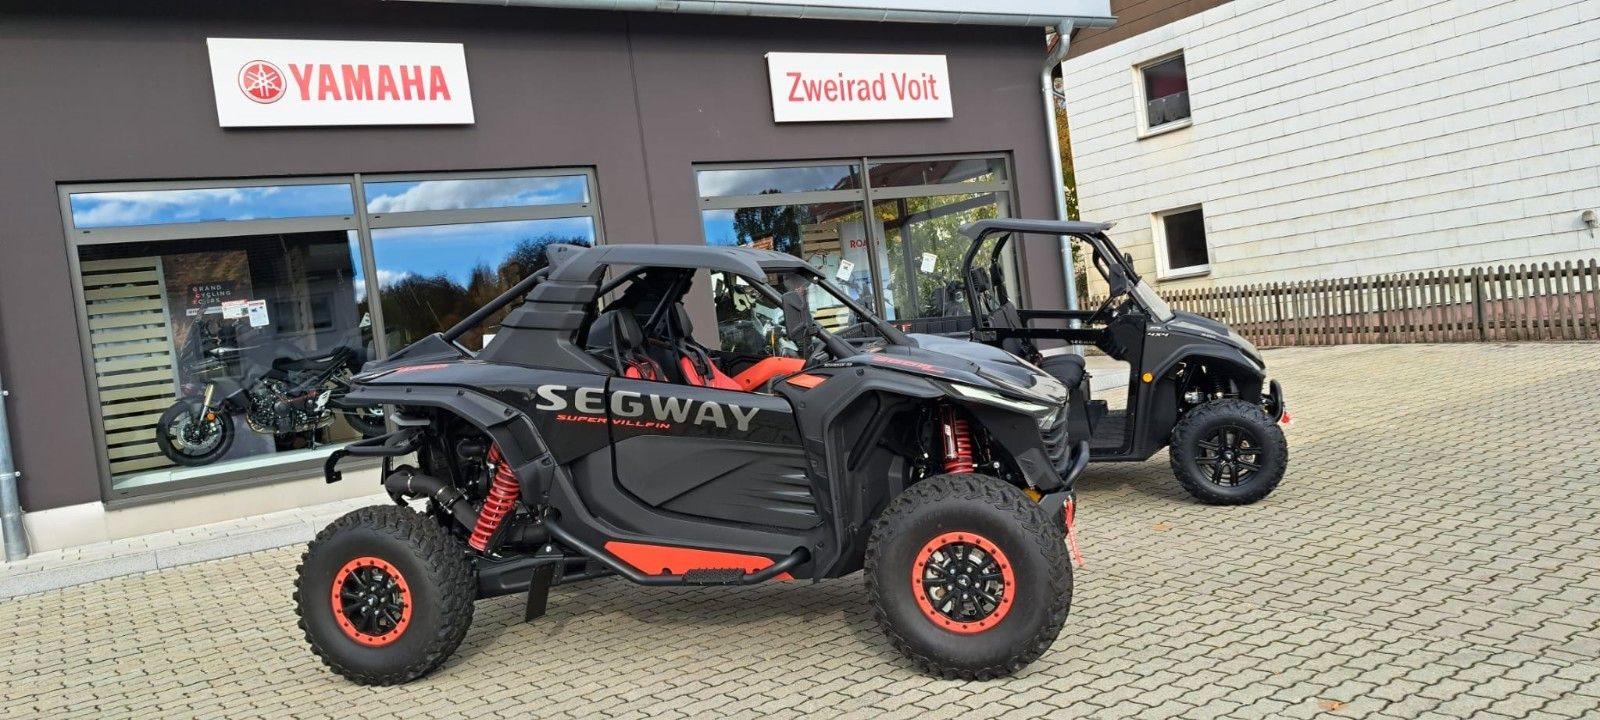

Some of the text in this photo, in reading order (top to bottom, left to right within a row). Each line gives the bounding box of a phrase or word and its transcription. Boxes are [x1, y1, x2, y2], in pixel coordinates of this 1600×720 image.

[288, 63, 452, 101] YAMAHA
[786, 72, 939, 102] Zweirad Voit
[192, 284, 222, 292] GRAND
[195, 290, 231, 298] CYCLING
[536, 384, 760, 432] SEGWAY
[556, 414, 607, 424] SUPER
